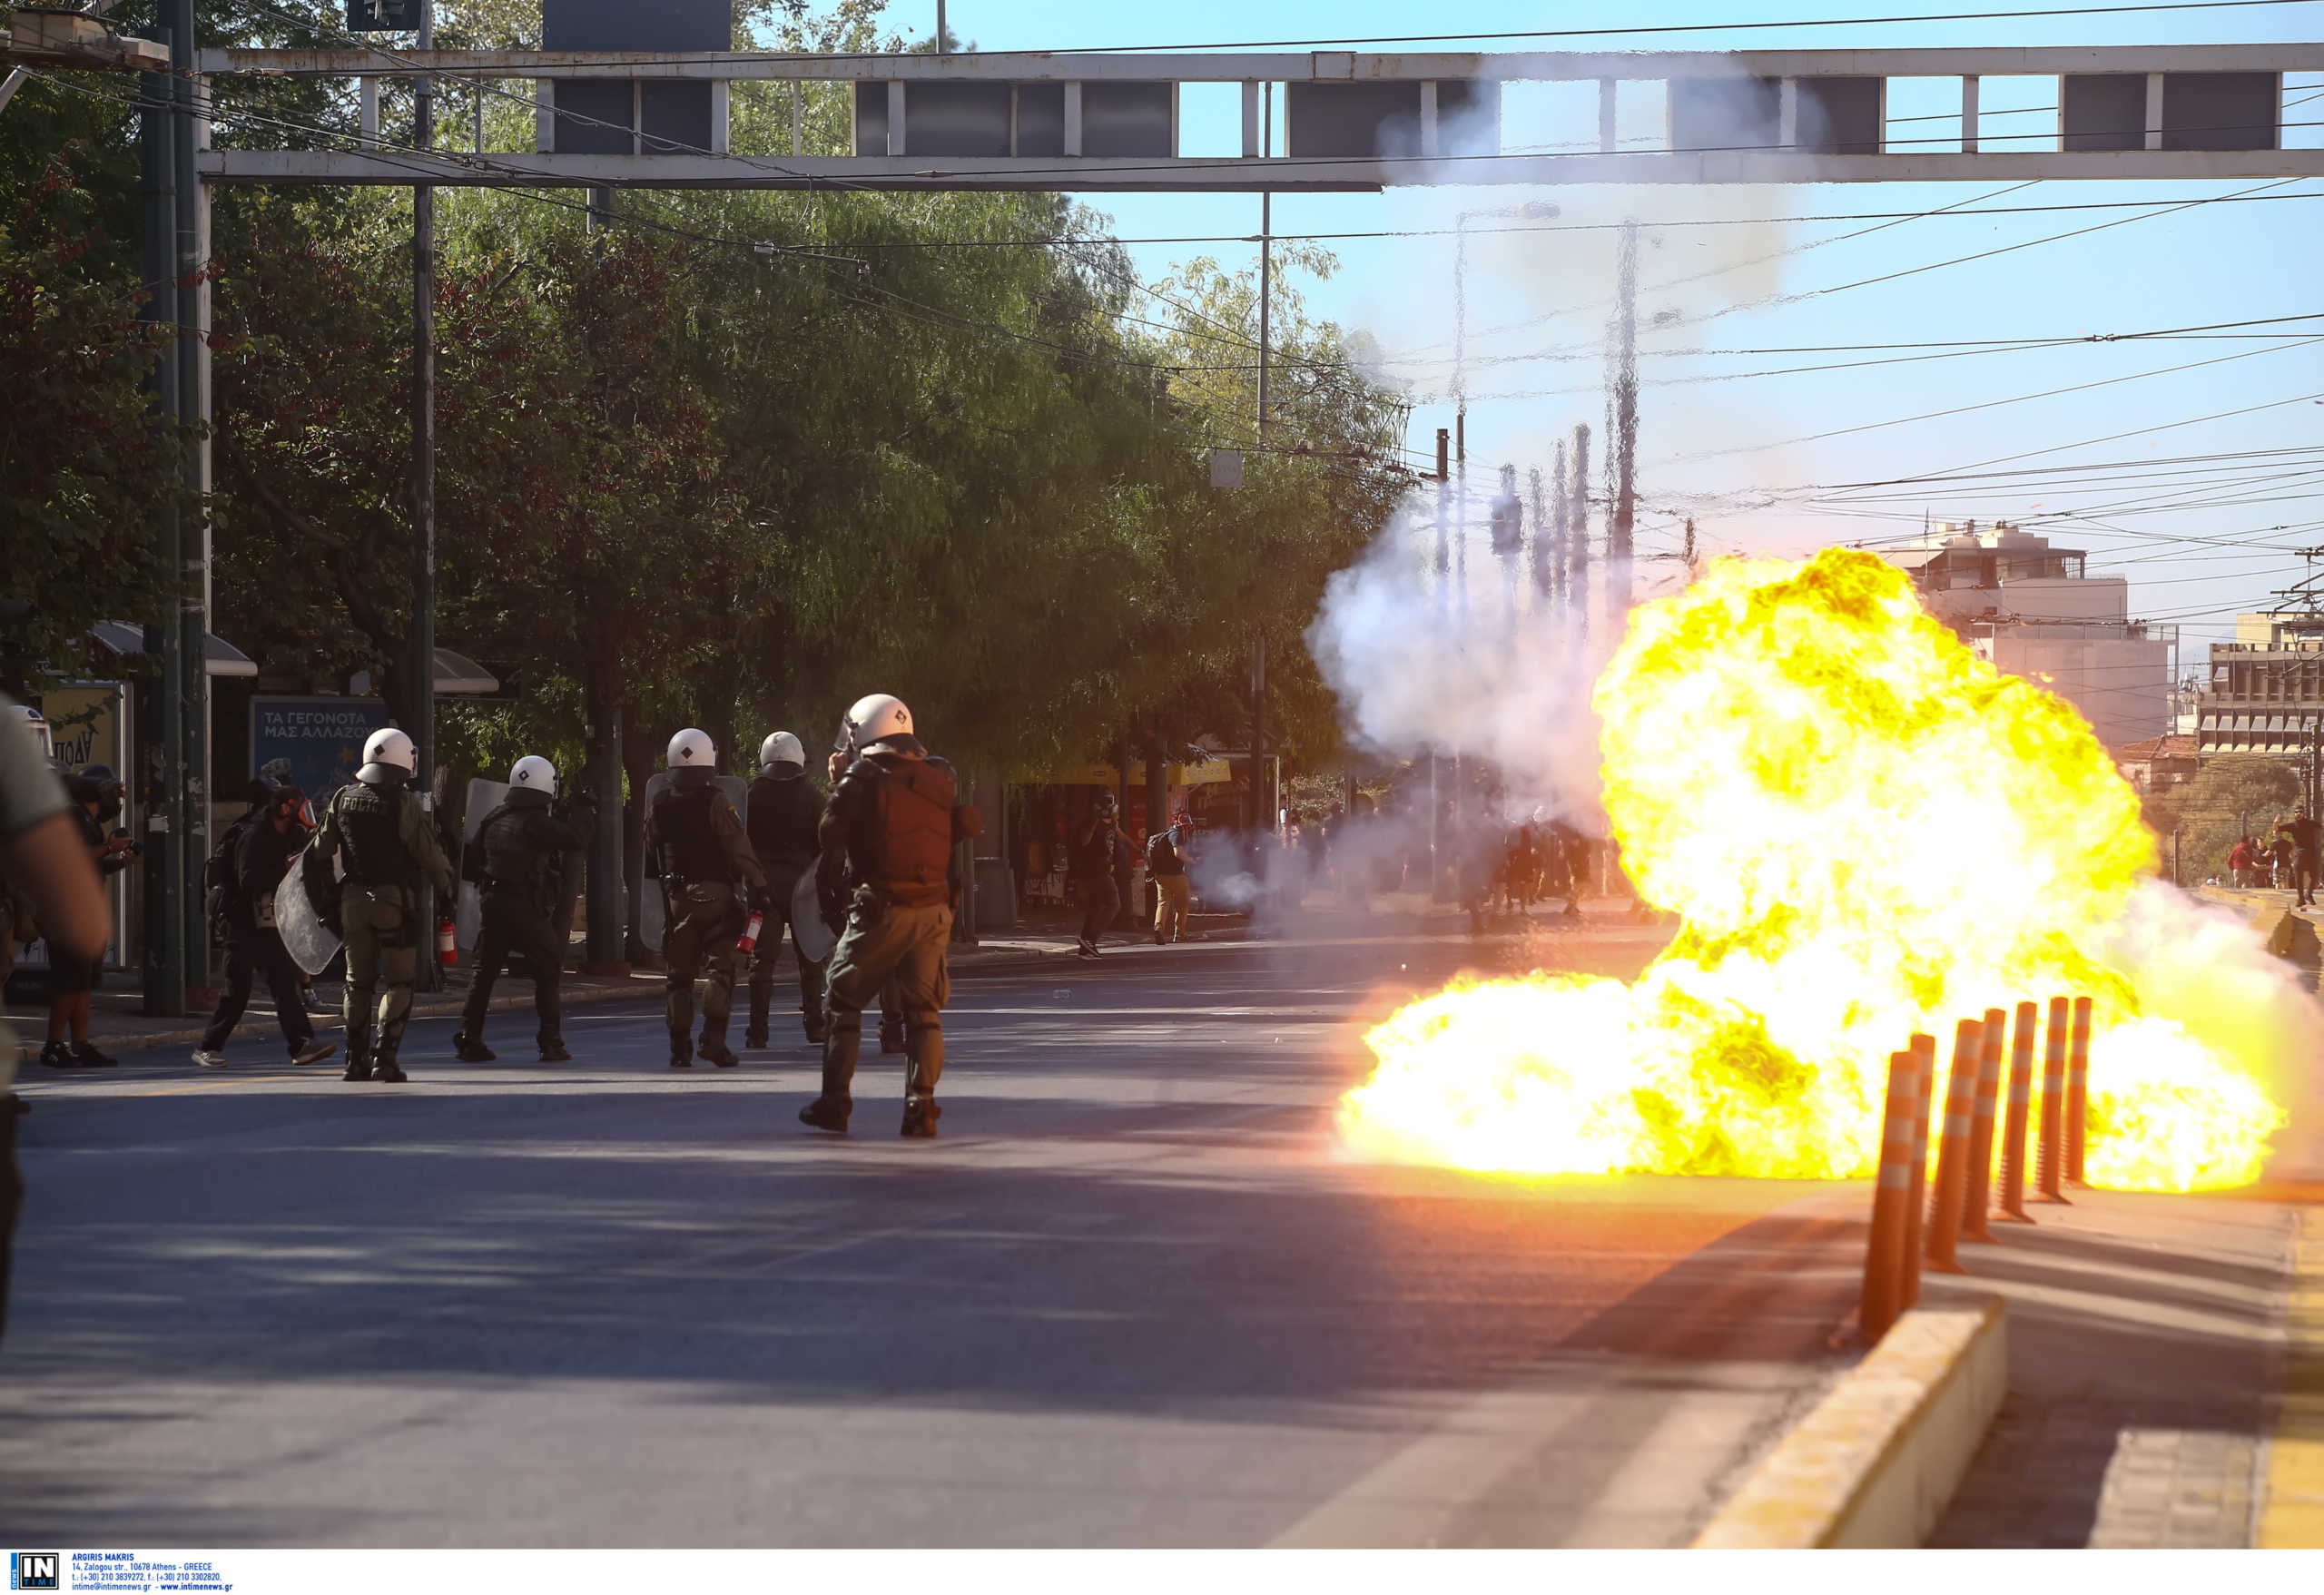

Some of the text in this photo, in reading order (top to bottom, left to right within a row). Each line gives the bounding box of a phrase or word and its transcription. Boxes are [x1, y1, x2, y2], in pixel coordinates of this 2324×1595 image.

[264, 712, 367, 724] ΤΑ ΓΕΓΟΝΟΤΑ
[264, 726, 298, 738] ΜΑΣ
